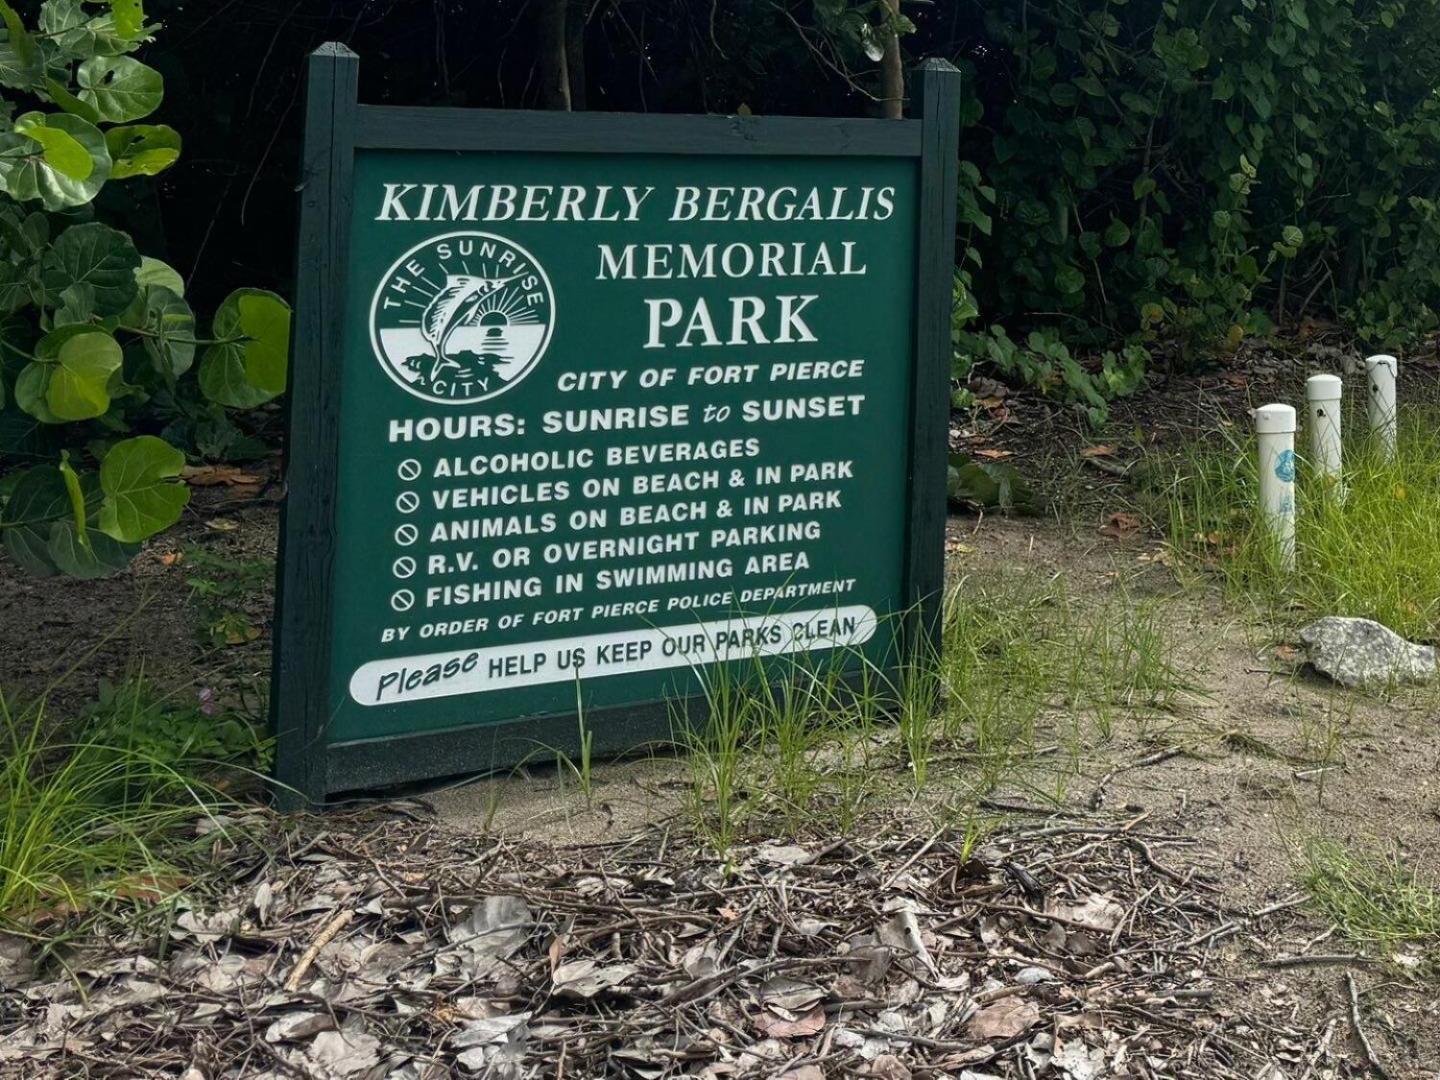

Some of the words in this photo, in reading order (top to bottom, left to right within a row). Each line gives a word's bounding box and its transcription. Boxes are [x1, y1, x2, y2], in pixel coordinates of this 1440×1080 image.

[374, 183, 655, 222] KIMBERLY
[668, 186, 895, 221] BERGALIS
[383, 259, 426, 310] THE
[436, 240, 544, 306] SUNRISE
[595, 241, 867, 280] MEMORIAL
[643, 294, 819, 349] PARK
[432, 377, 489, 397] CITY
[557, 370, 628, 392] CITY
[639, 368, 677, 388] OF
[687, 364, 760, 386] FORT
[769, 359, 865, 382] PIERCE
[388, 413, 525, 443] HOURS:
[542, 404, 690, 434] SUNRISE
[703, 404, 731, 423] to
[742, 394, 866, 423] SUNSET
[433, 448, 594, 478] ALCOHOLIC
[606, 437, 760, 466] BEVERAGES
[432, 480, 570, 510] VEHICLES
[582, 477, 620, 499] ON
[632, 470, 719, 495] BEACH
[728, 468, 745, 488] &
[756, 465, 781, 485] IN
[790, 460, 853, 483] PARK
[430, 512, 557, 543] ANIMALS
[569, 509, 607, 531] ON
[620, 501, 707, 526] BEACH
[716, 499, 733, 518] &
[744, 495, 769, 516] IN
[778, 490, 842, 513] PARK
[428, 551, 479, 575] R.V.
[492, 546, 531, 569] OR
[543, 531, 700, 564] OVERNIGHT
[711, 520, 821, 548] PARKING
[426, 576, 542, 608] FISHING
[555, 572, 583, 594] IN
[596, 558, 733, 590] SWIMMING
[744, 551, 810, 575] AREA
[381, 626, 411, 643] BY
[419, 617, 489, 639] ORDER
[497, 613, 525, 630] OF
[532, 607, 584, 626] FORT
[591, 599, 660, 619] PIERCE
[667, 591, 733, 611] POLICE
[740, 579, 856, 602] DEPARTMENT
[376, 652, 479, 701] Please
[489, 653, 546, 678] HELP
[557, 647, 585, 670] US
[597, 640, 652, 665] KEEP
[662, 634, 705, 657] OUR
[716, 625, 782, 651] PARKS
[792, 617, 856, 641] CLEAN
